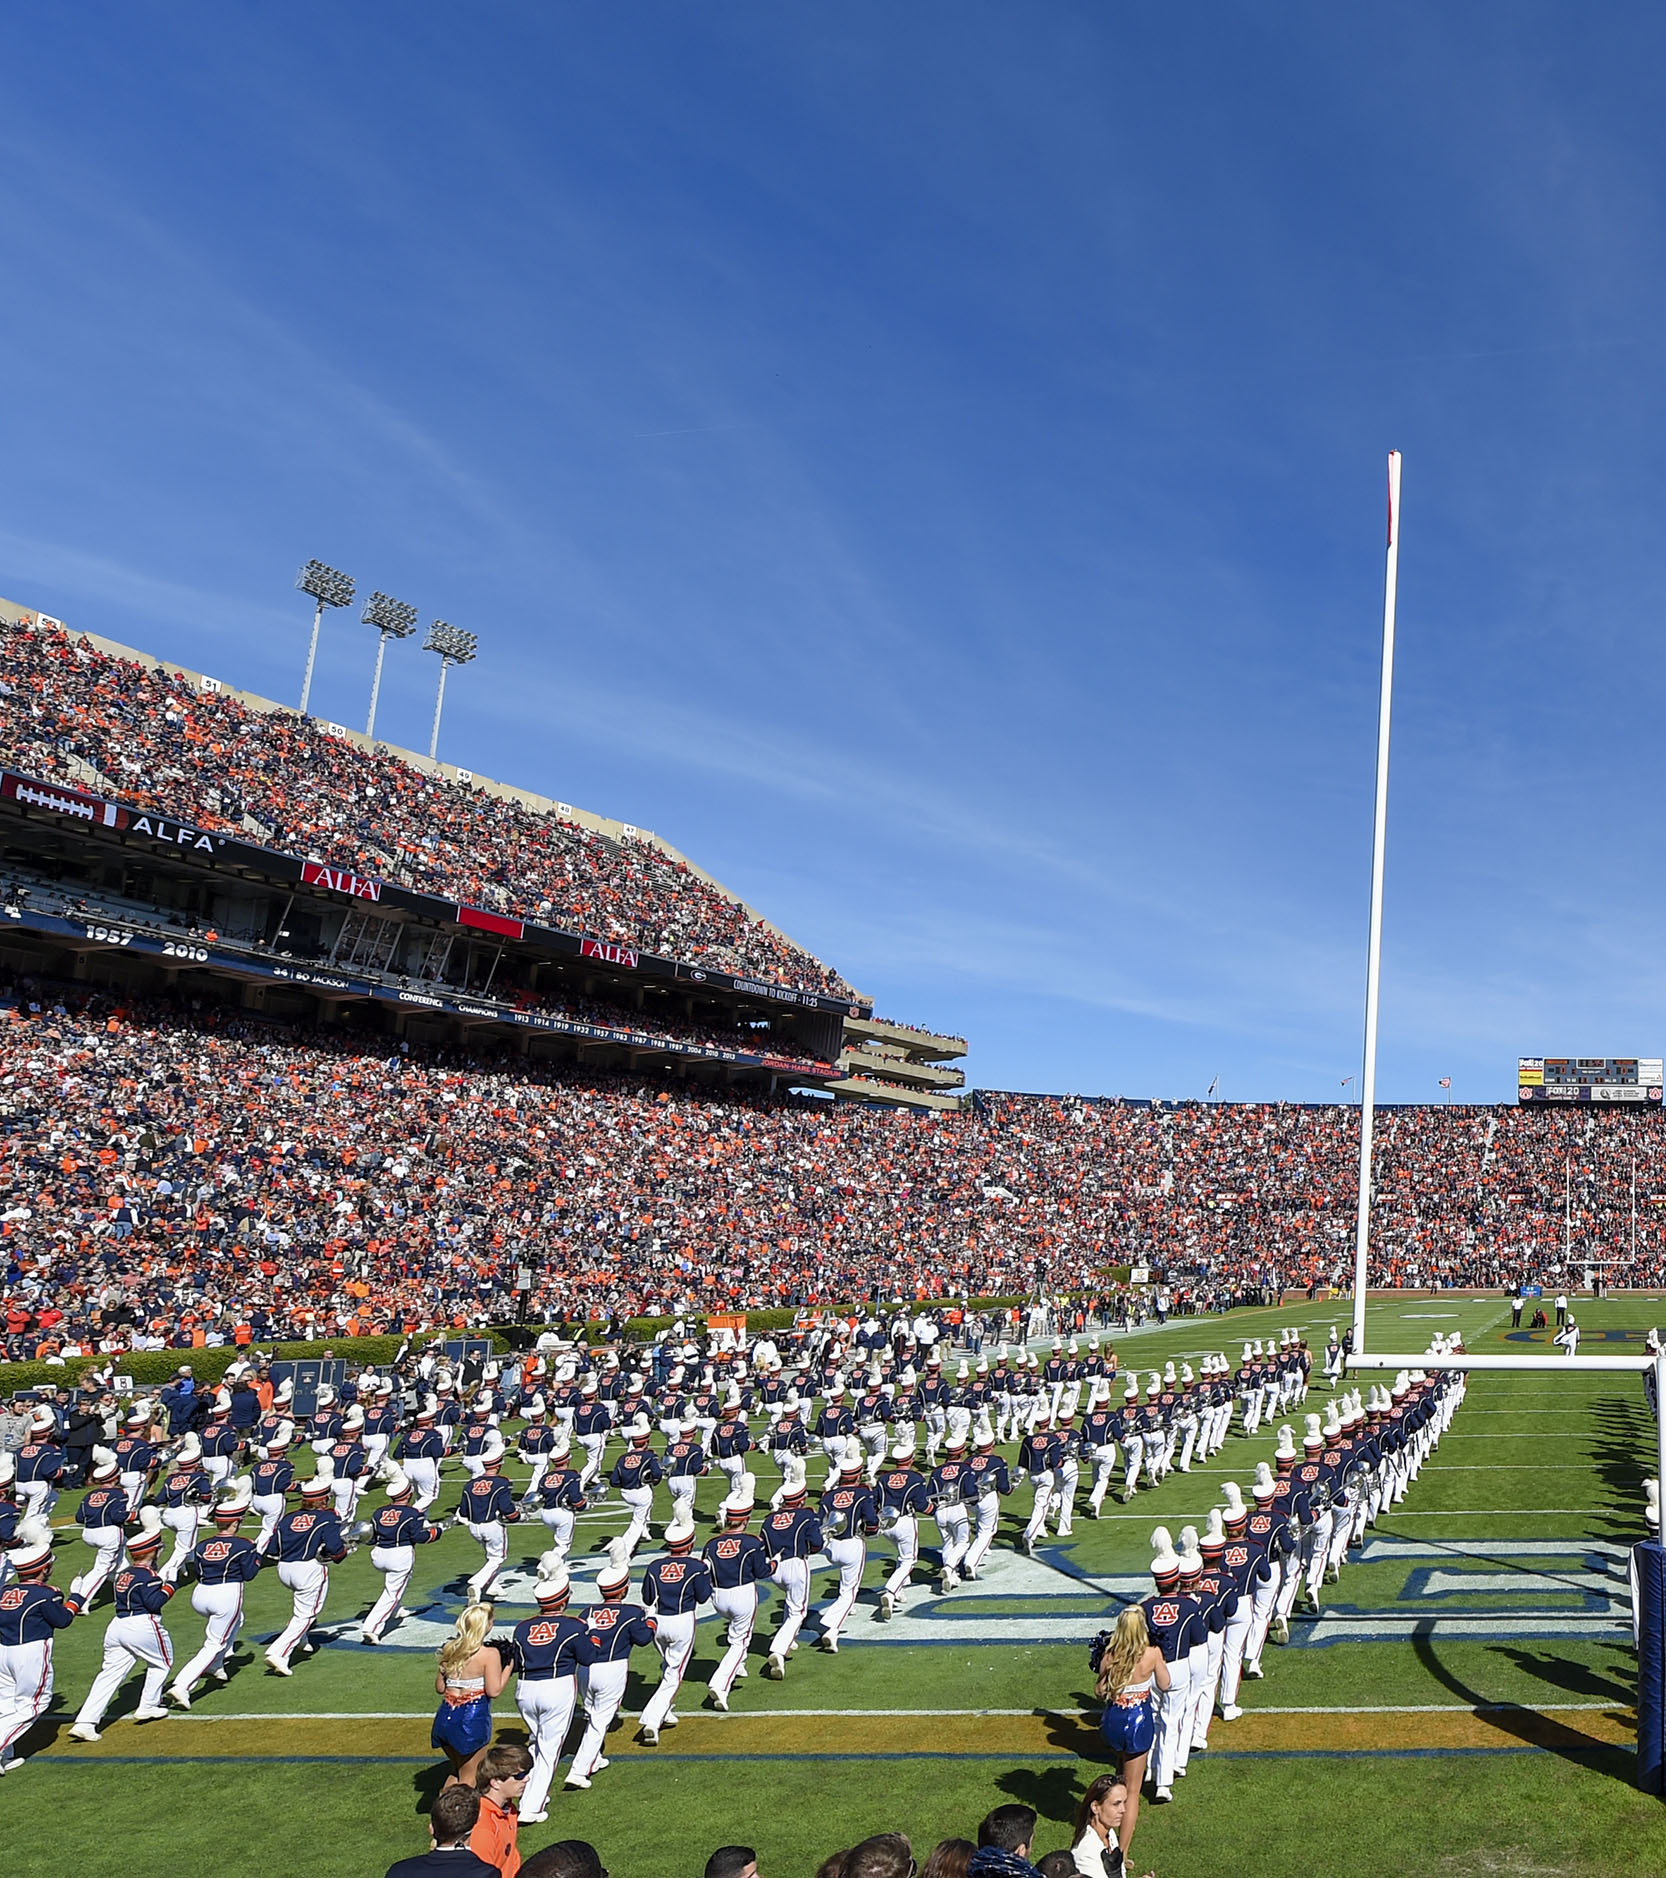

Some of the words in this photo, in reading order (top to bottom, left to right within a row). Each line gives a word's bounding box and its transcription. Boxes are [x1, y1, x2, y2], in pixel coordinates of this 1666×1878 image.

[205, 680, 217, 692] 51
[331, 725, 343, 735] 50
[459, 770, 470, 779] 49
[132, 815, 214, 853] ALFA
[313, 868, 380, 901] ALFA
[86, 925, 135, 946] 1957
[161, 942, 209, 962] 2010
[589, 942, 637, 967] ALFA
[312, 975, 349, 988] JACKSON
[733, 979, 768, 996] COUNTDOWN
[776, 989, 797, 1003] KICKOFF
[399, 991, 443, 1007] CONFERENCE
[458, 1004, 498, 1018] CHAMPIONS
[514, 1014, 529, 1023] 1913
[534, 1017, 550, 1027] 1914
[553, 1020, 569, 1031] 1919
[573, 1025, 589, 1034] 1932
[811, 1067, 842, 1078] STADIUM
